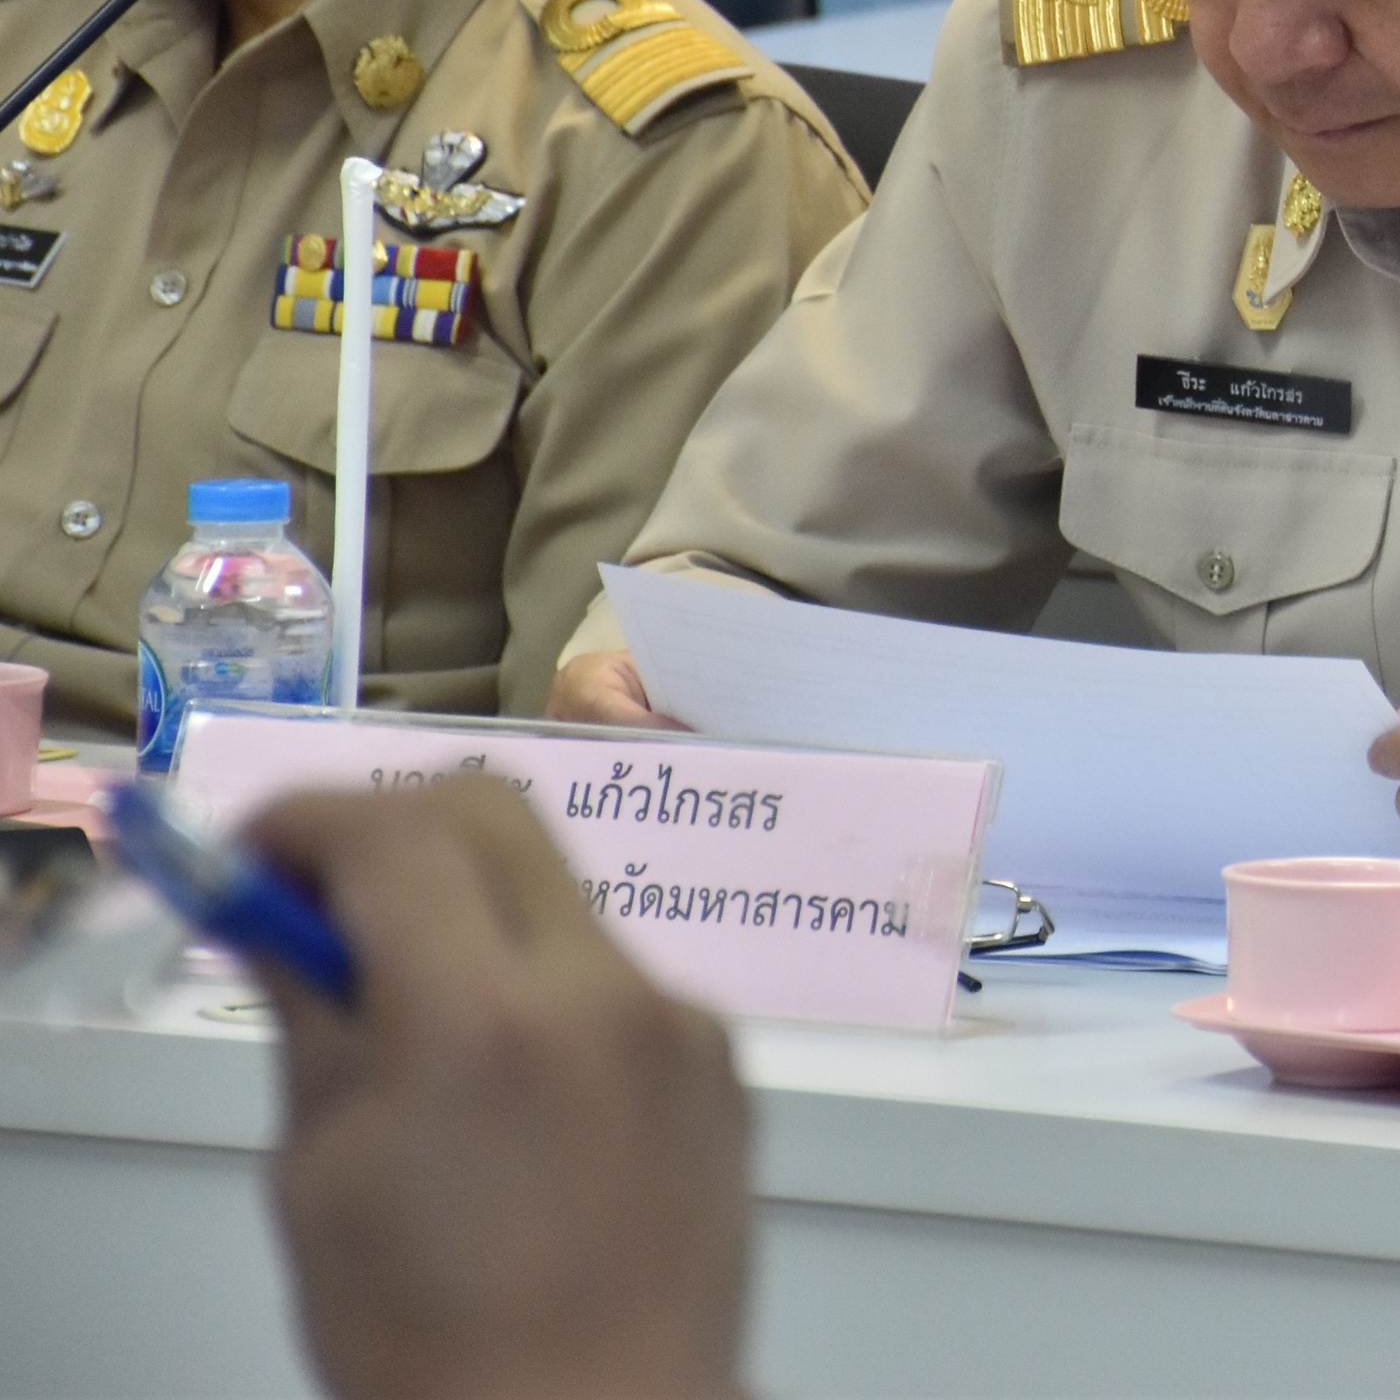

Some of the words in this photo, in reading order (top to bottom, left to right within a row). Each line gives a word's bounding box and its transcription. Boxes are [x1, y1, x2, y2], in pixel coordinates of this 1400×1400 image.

[565, 761, 784, 832] แก้วไกรสร
[581, 862, 911, 938] หวัดมหาสารคาม
